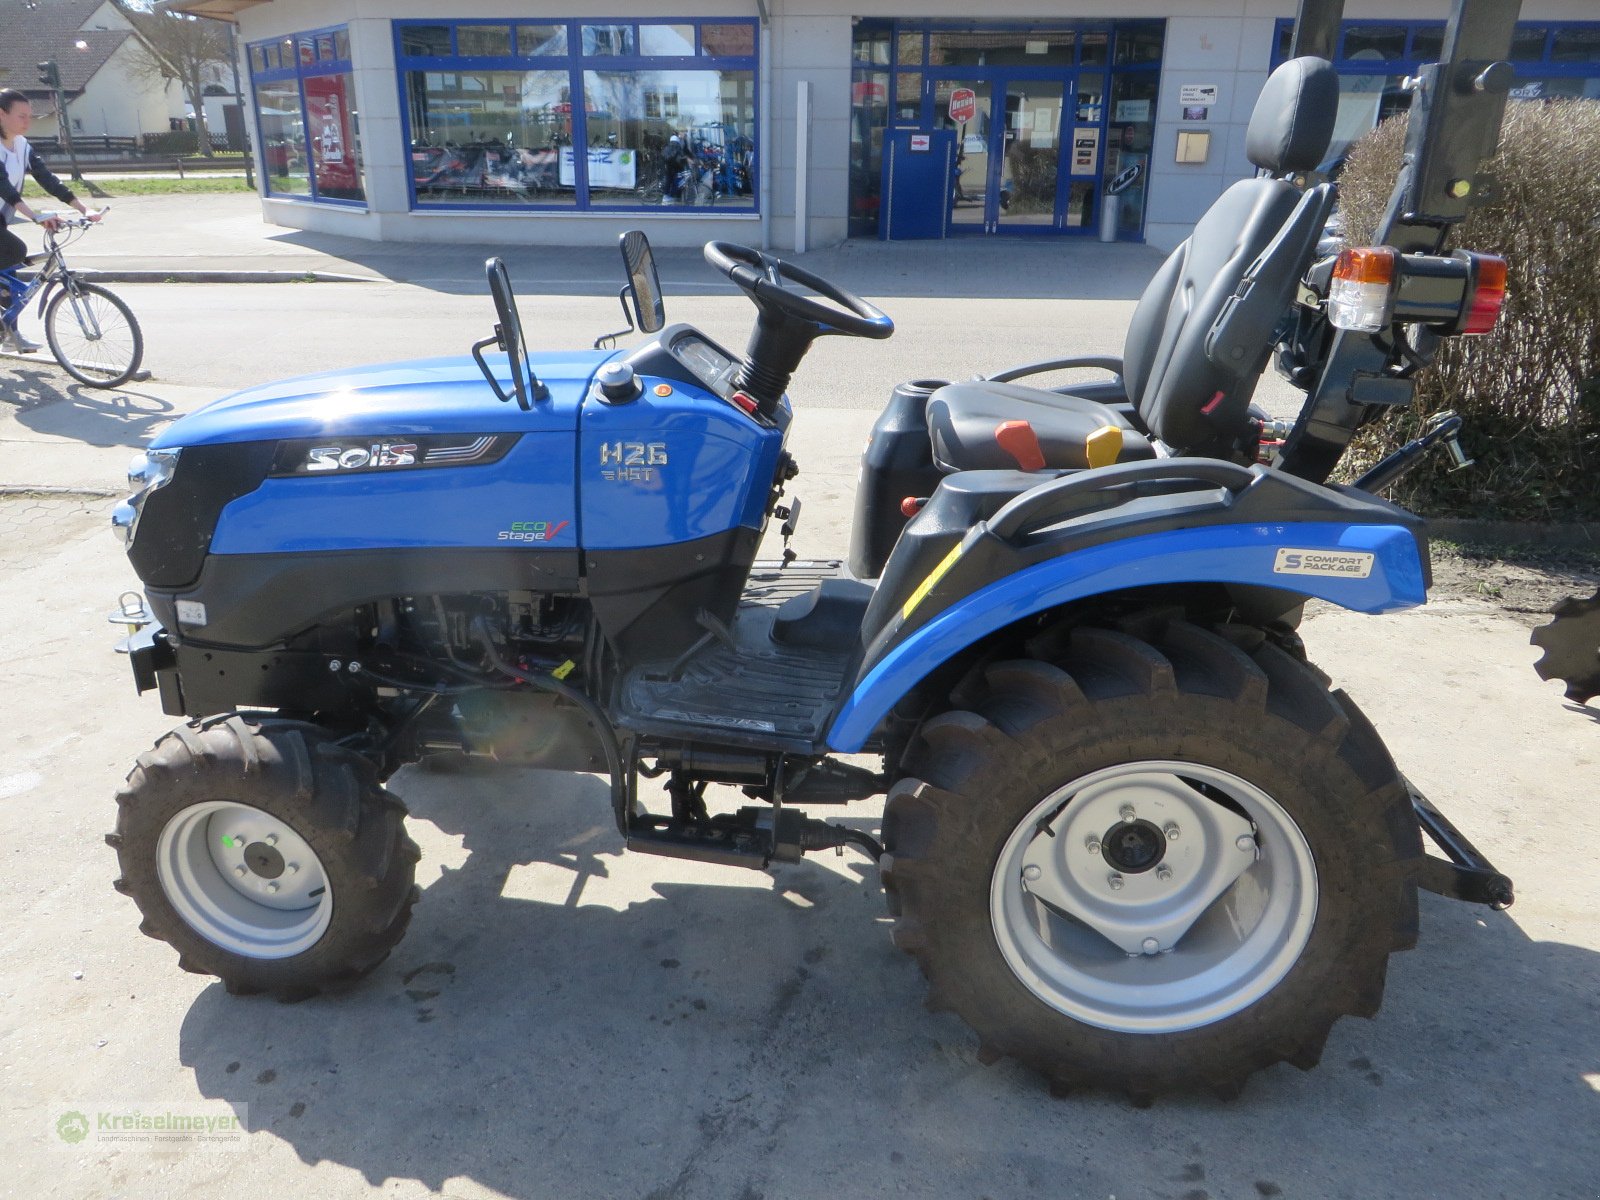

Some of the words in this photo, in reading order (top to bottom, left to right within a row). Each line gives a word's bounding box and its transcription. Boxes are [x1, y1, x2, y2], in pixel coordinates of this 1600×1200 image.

[600, 442, 667, 465] H26
[617, 467, 653, 480] HST
[511, 521, 547, 531] ECO
[497, 531, 546, 542] Stage
[1305, 556, 1363, 565] COMFORT
[1303, 563, 1361, 572] PACKAGE
